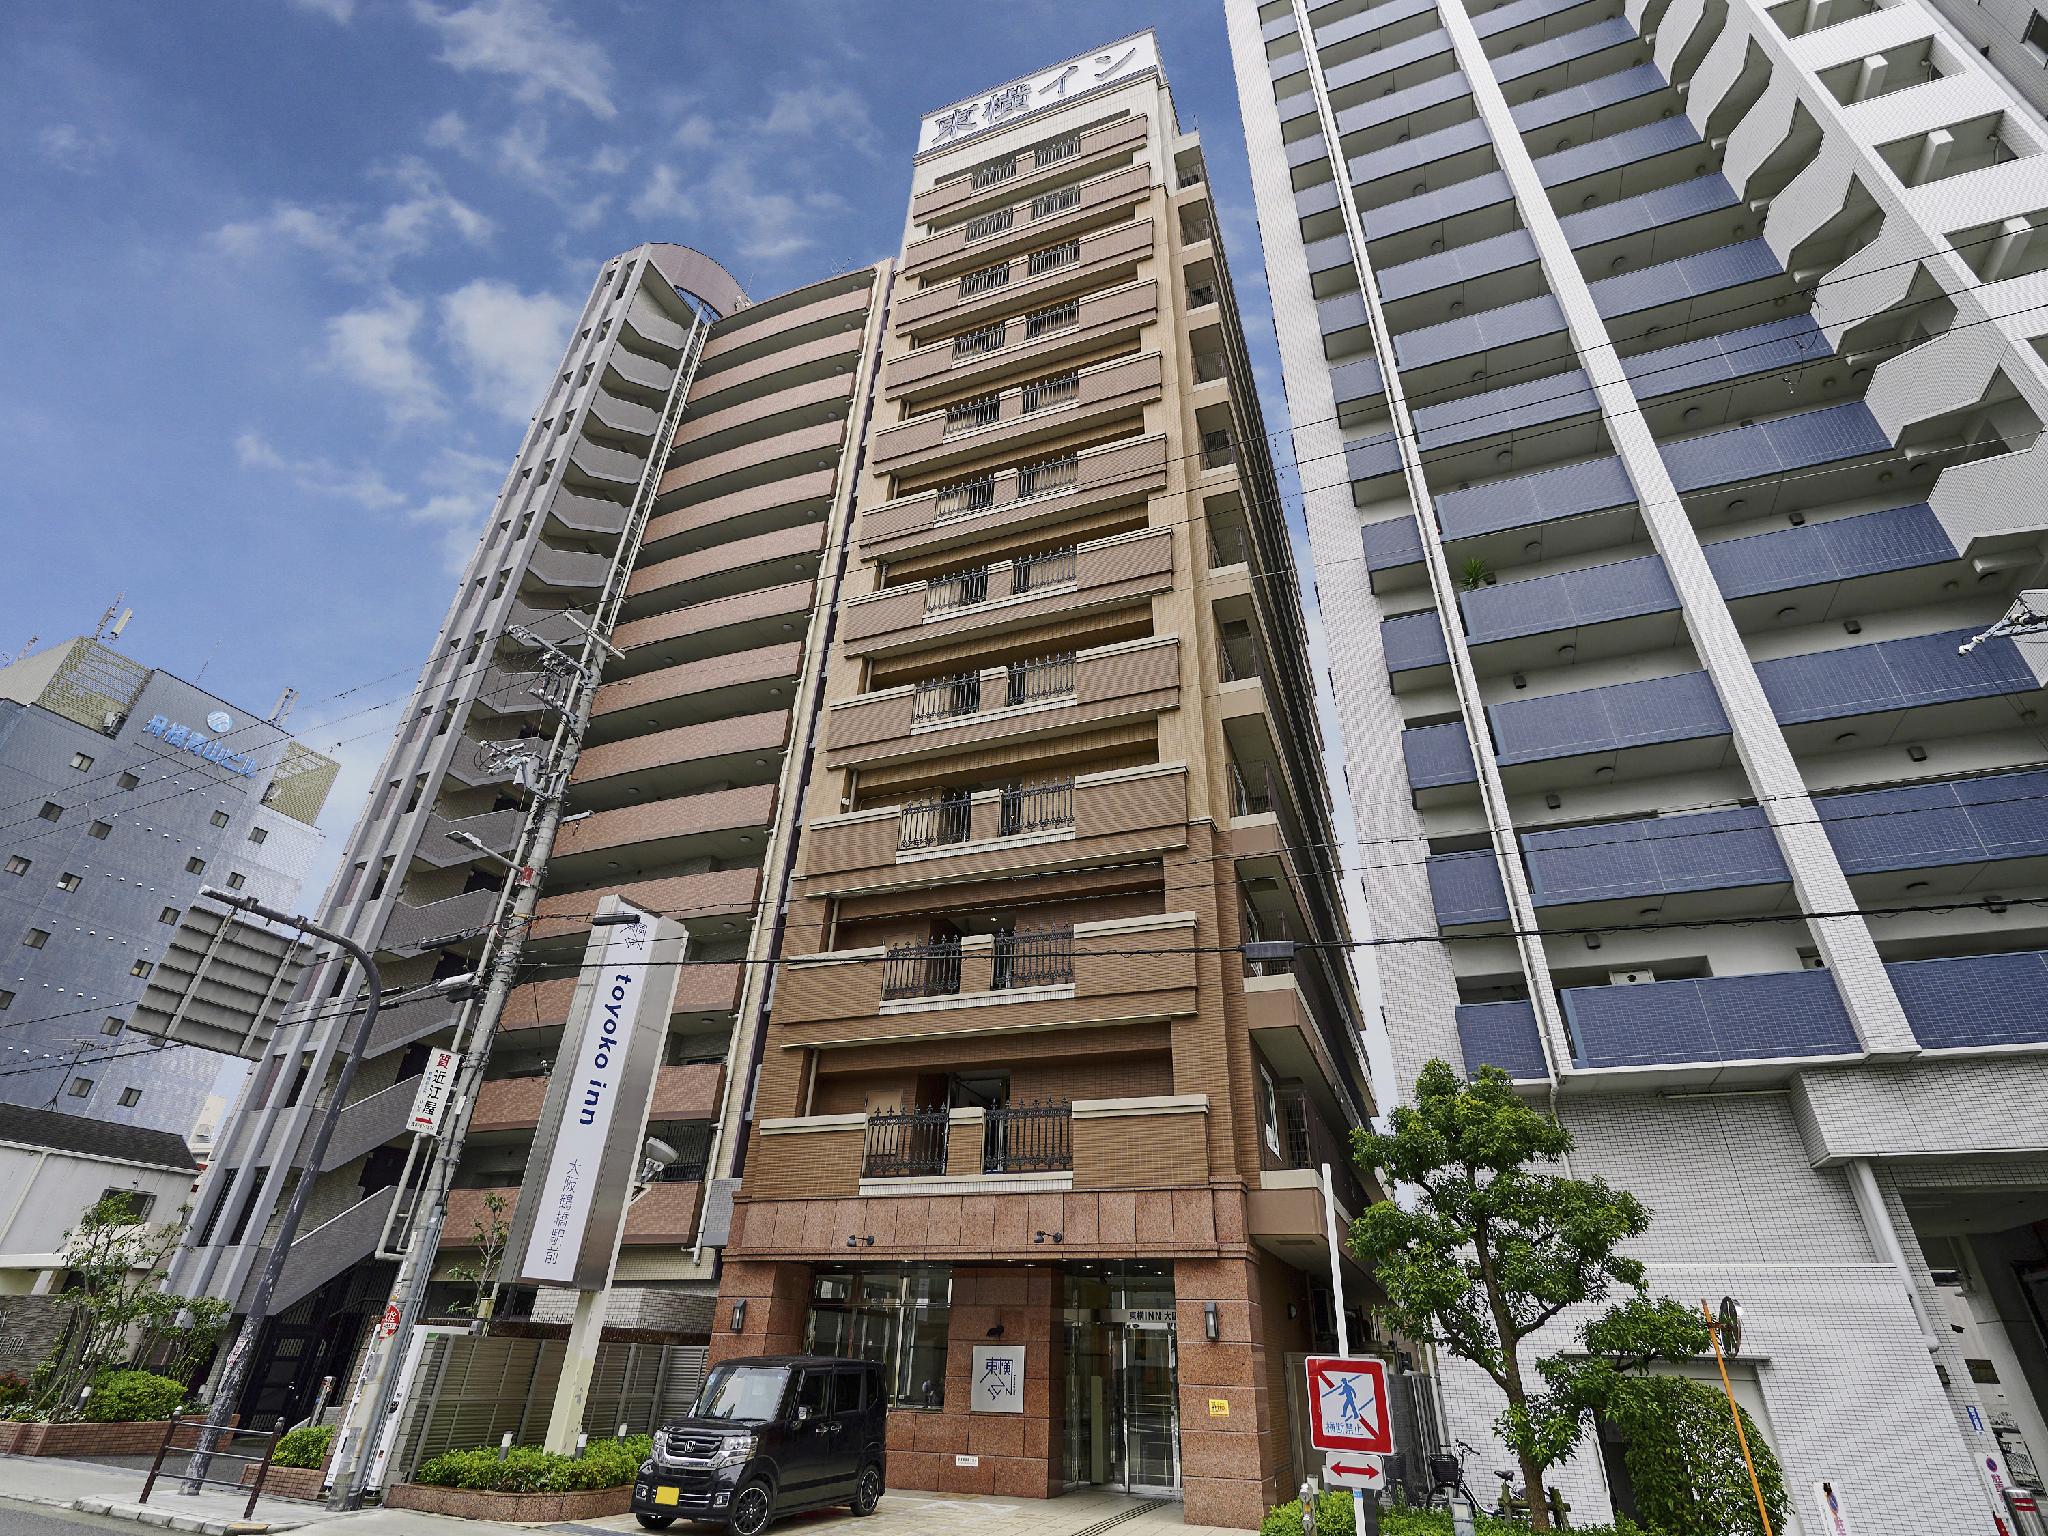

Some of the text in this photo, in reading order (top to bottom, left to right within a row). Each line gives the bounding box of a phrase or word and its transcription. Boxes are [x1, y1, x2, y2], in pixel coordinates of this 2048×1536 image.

[932, 47, 1136, 144] 東横イン
[579, 974, 632, 1125] toyoko inn
[1326, 1421, 1364, 1436] 横断禁止
